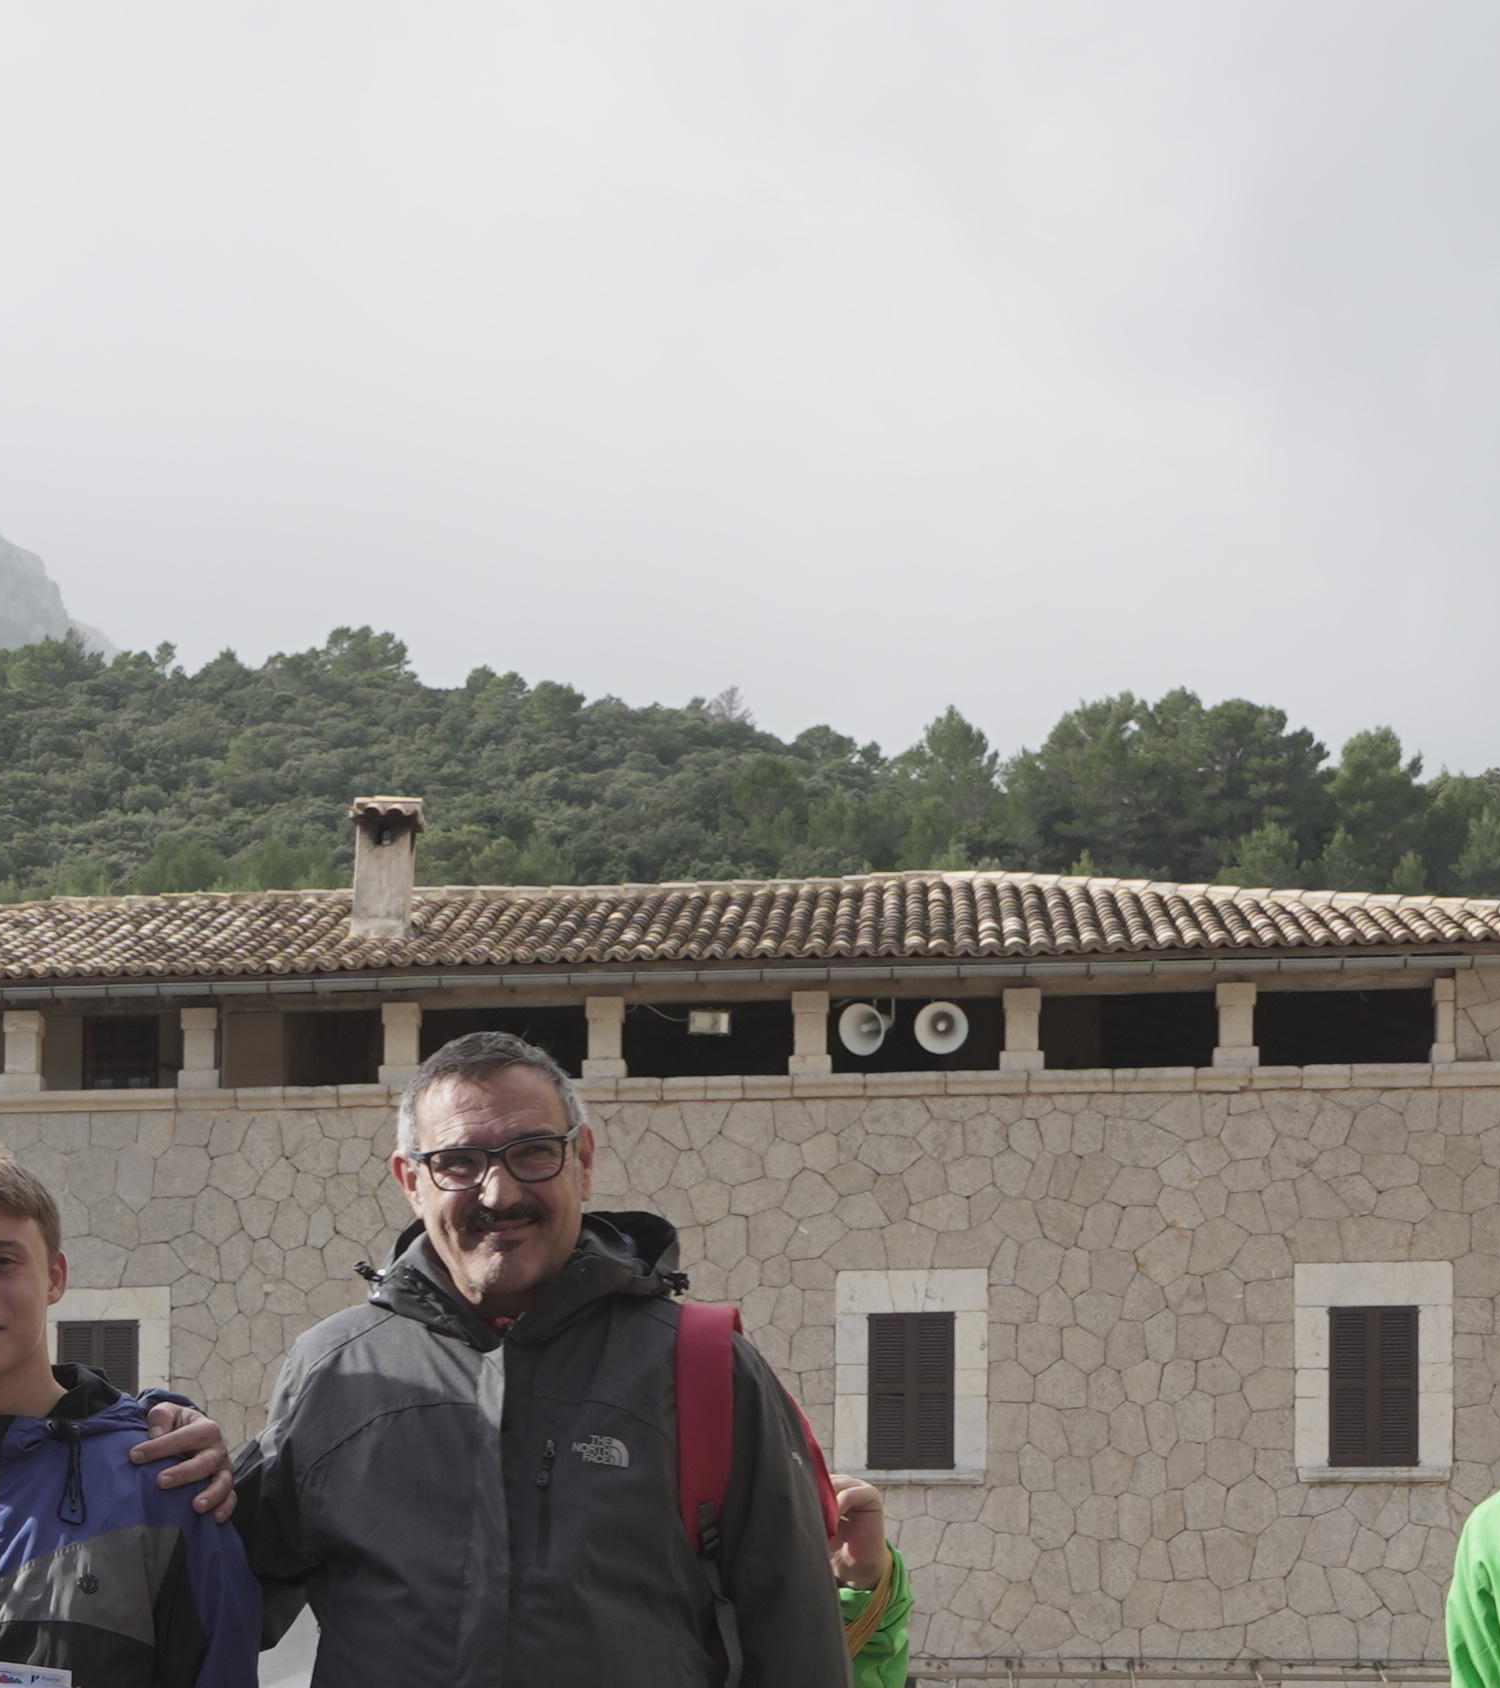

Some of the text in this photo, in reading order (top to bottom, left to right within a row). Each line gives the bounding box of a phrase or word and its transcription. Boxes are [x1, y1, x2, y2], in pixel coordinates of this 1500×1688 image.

[589, 1435, 613, 1446] THE
[572, 1442, 611, 1455] NORTH
[582, 1453, 611, 1465] FACE
